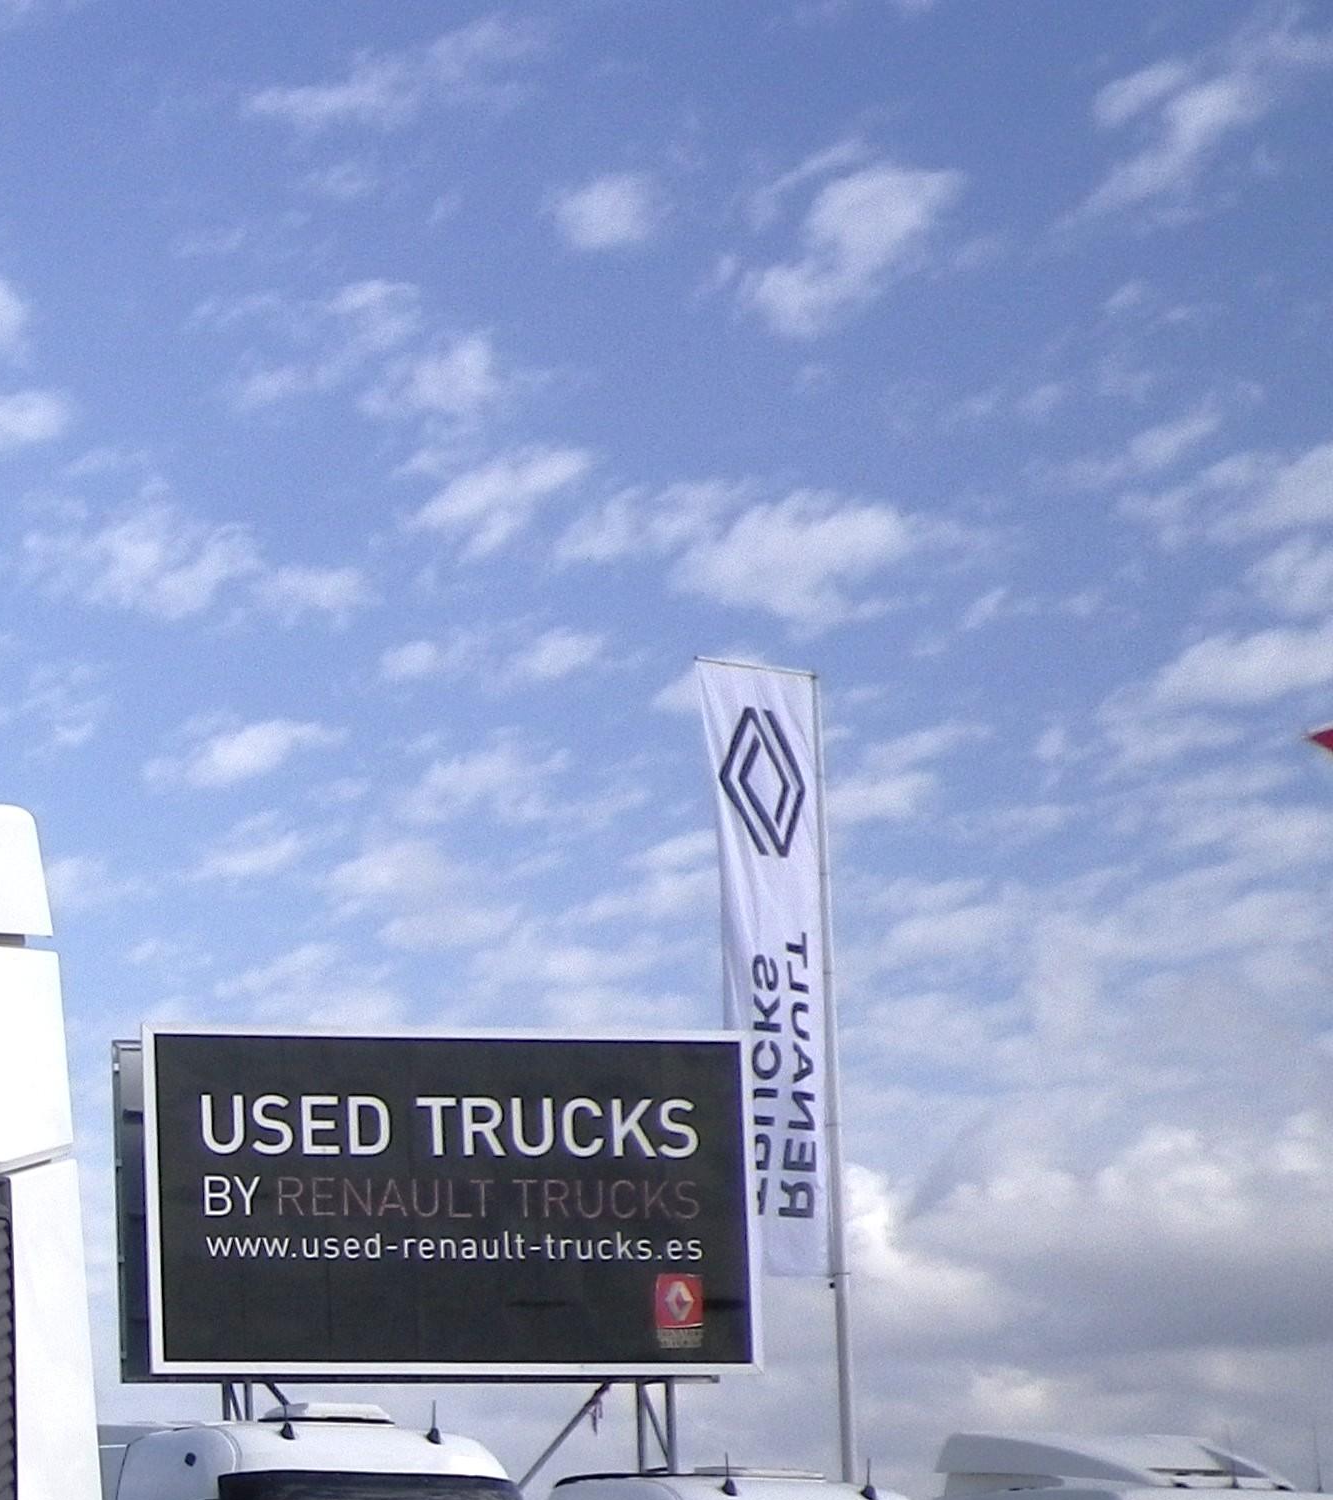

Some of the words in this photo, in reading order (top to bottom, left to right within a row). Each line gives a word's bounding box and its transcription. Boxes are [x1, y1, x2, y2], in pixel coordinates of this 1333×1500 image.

[200, 1093, 391, 1156] USED
[415, 1096, 700, 1159] TRUCKS
[203, 1174, 261, 1217] BY
[276, 1176, 495, 1219] RENAULT
[511, 1178, 701, 1220] TRUCKS
[205, 1229, 704, 1262] www.used-renault-trucks.es
